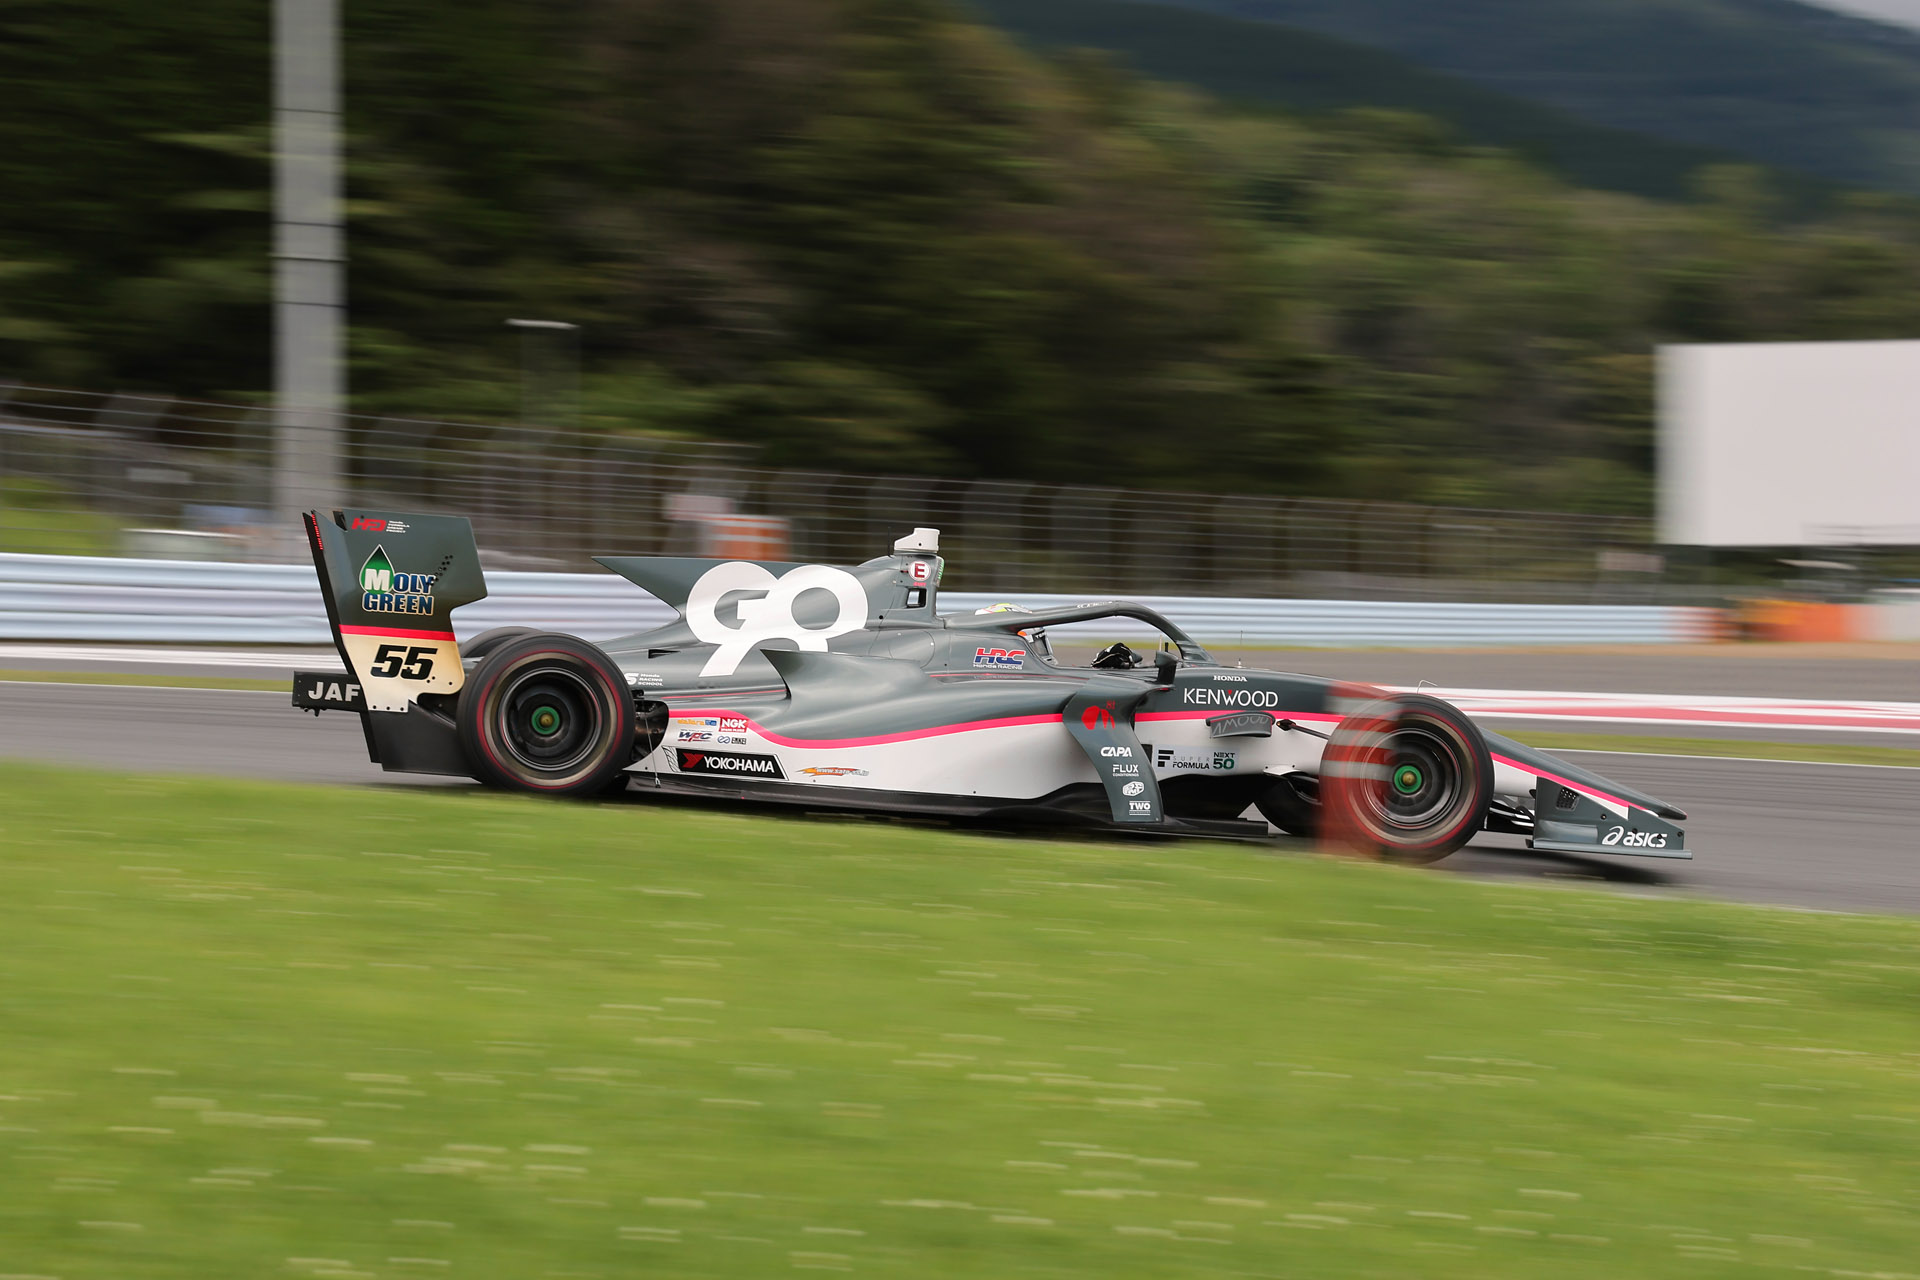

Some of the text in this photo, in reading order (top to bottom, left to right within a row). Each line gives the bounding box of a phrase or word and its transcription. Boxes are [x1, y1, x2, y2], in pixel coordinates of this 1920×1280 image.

[914, 562, 926, 578] E
[363, 568, 437, 595] MOLY
[362, 592, 434, 616] GREEN
[370, 644, 438, 680] 55
[974, 648, 1027, 666] HRC
[308, 681, 361, 702] JAF
[1183, 687, 1279, 708] KENWOOD
[721, 718, 748, 729] NGK
[1101, 746, 1133, 757] CAPA
[703, 755, 776, 773] YOKOHAMA
[1112, 764, 1139, 773] FLUX
[1173, 761, 1210, 770] FORMULA
[1212, 758, 1235, 770] 50
[1129, 802, 1151, 810] TWO
[1622, 831, 1668, 848] asics
